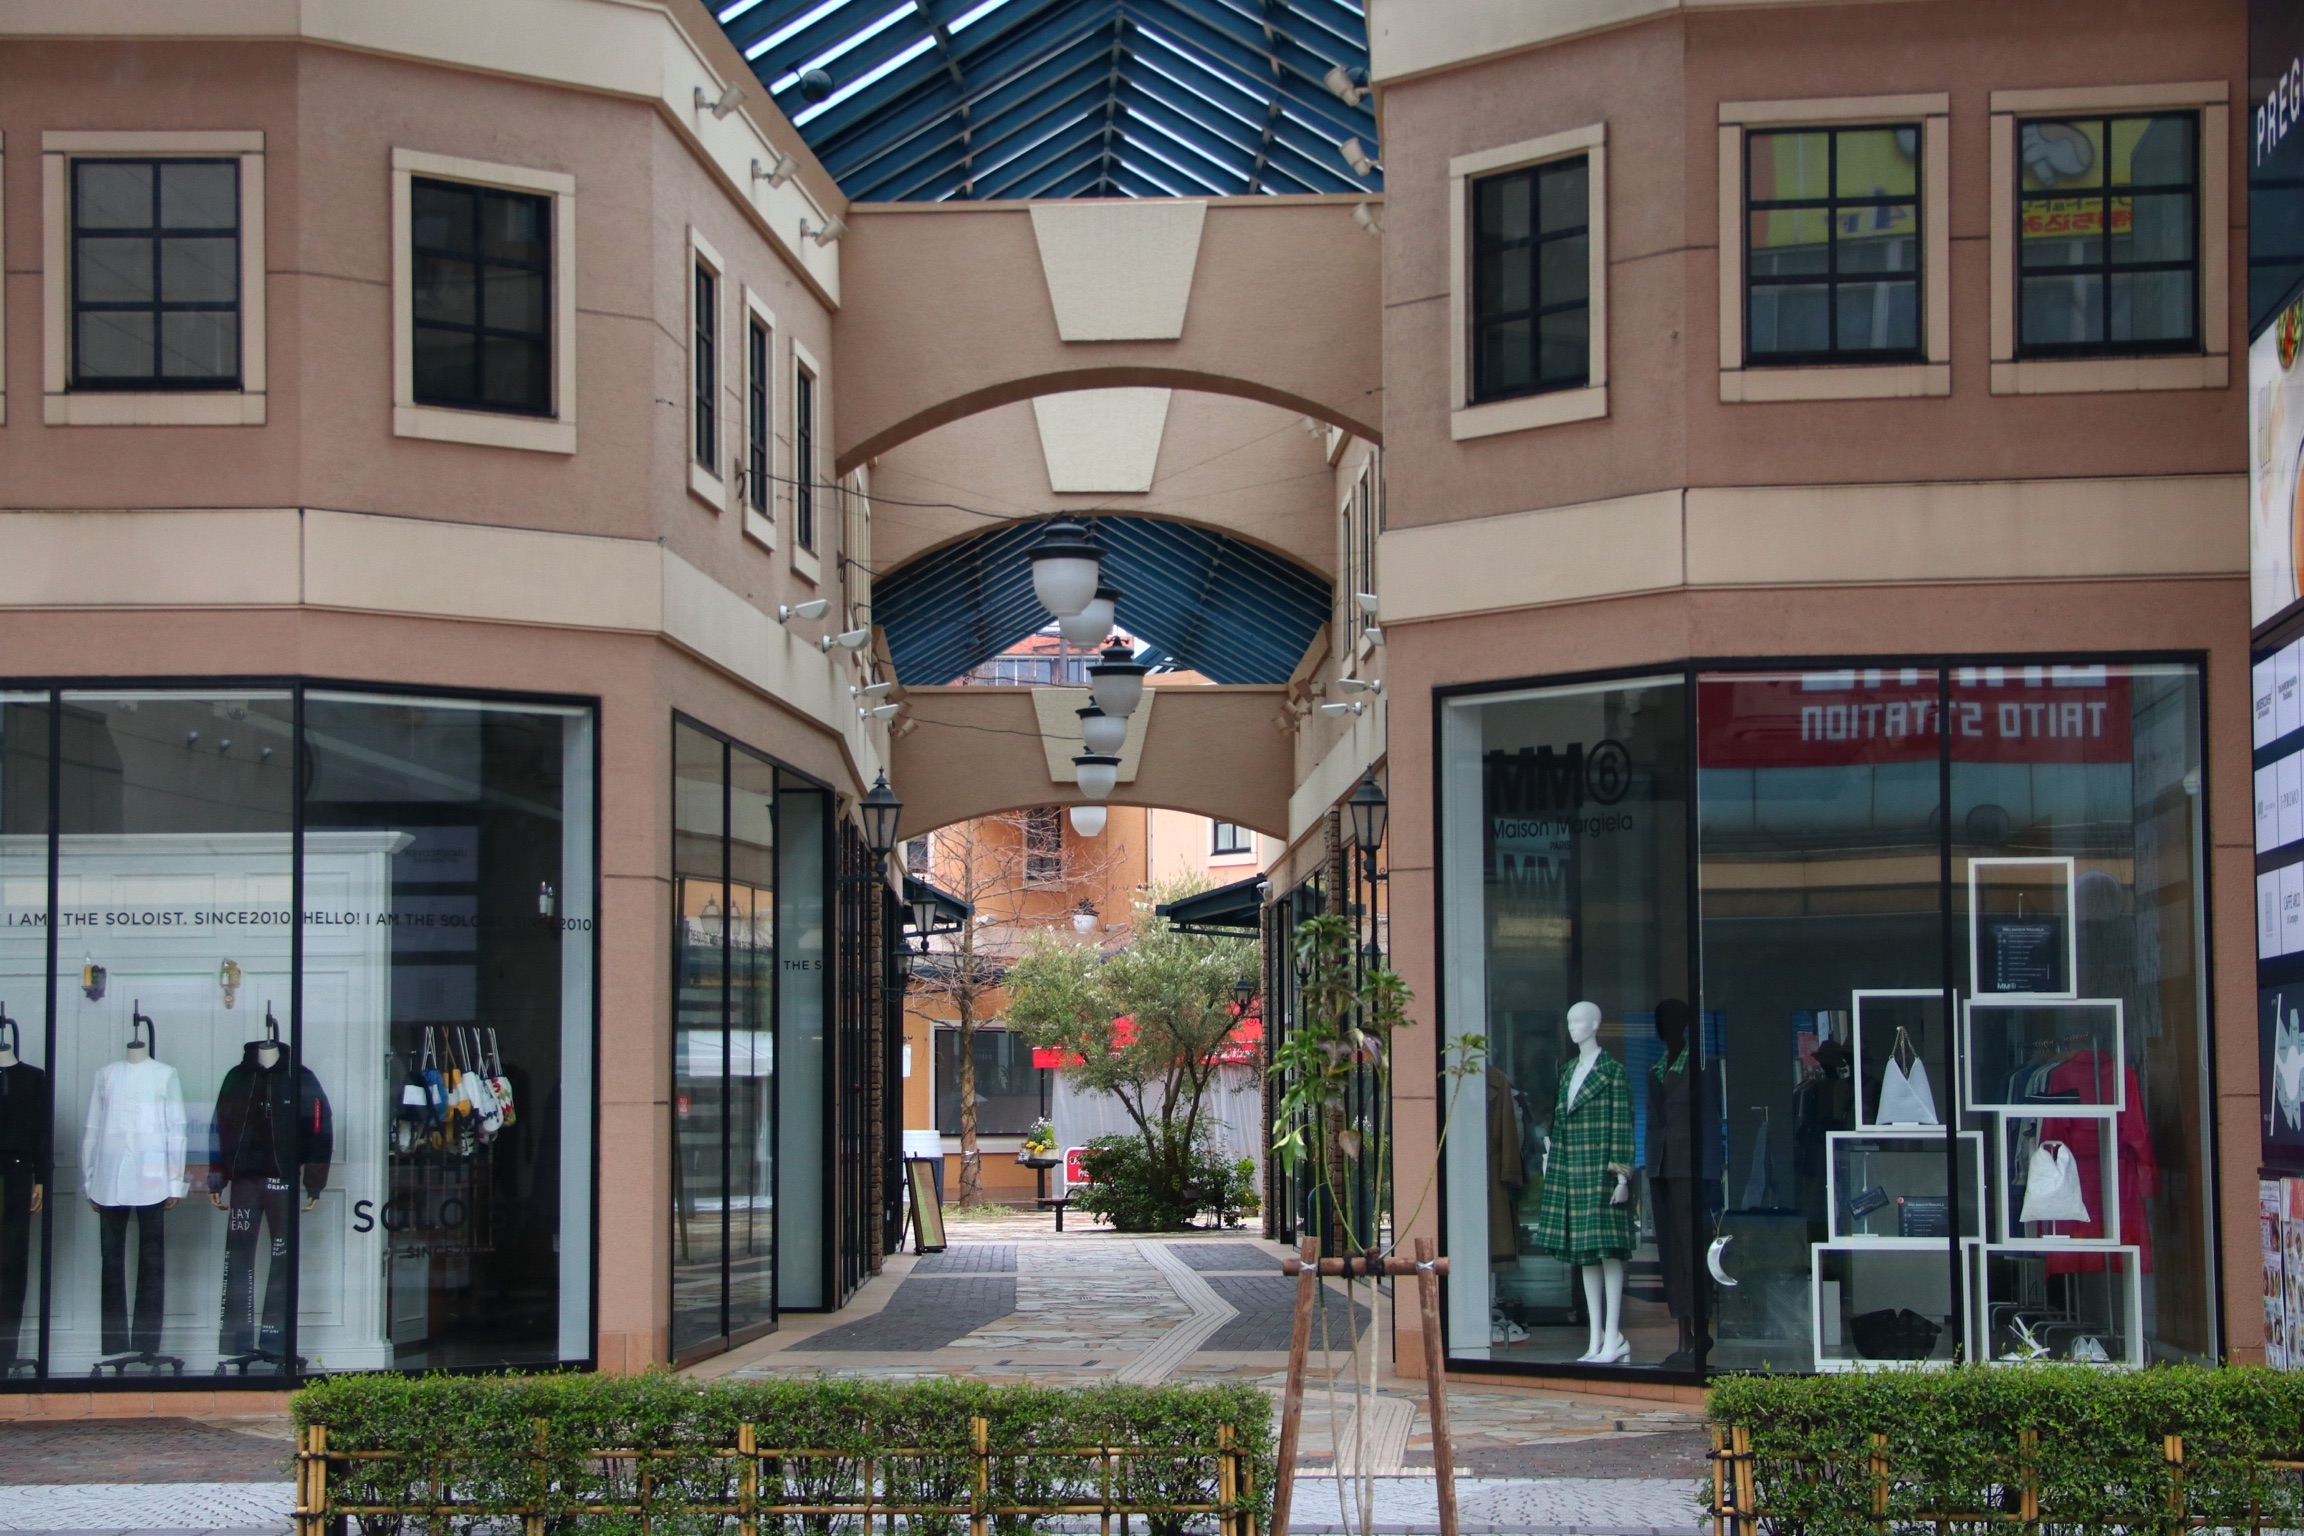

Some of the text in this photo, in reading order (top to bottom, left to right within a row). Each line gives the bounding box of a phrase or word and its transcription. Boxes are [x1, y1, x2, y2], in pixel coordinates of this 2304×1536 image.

[2256, 57, 2304, 167] PREG
[1492, 812, 1633, 839] Maison Margiela
[1550, 841, 1572, 851] PARIS
[20, 913, 47, 926] AM
[63, 911, 291, 926] THE SOLOIST. SINCE2010
[303, 911, 360, 925] HELLO!
[376, 913, 399, 926] AM
[407, 914, 434, 927] THE
[784, 960, 809, 971] THE
[267, 1183, 290, 1191] GREAT
